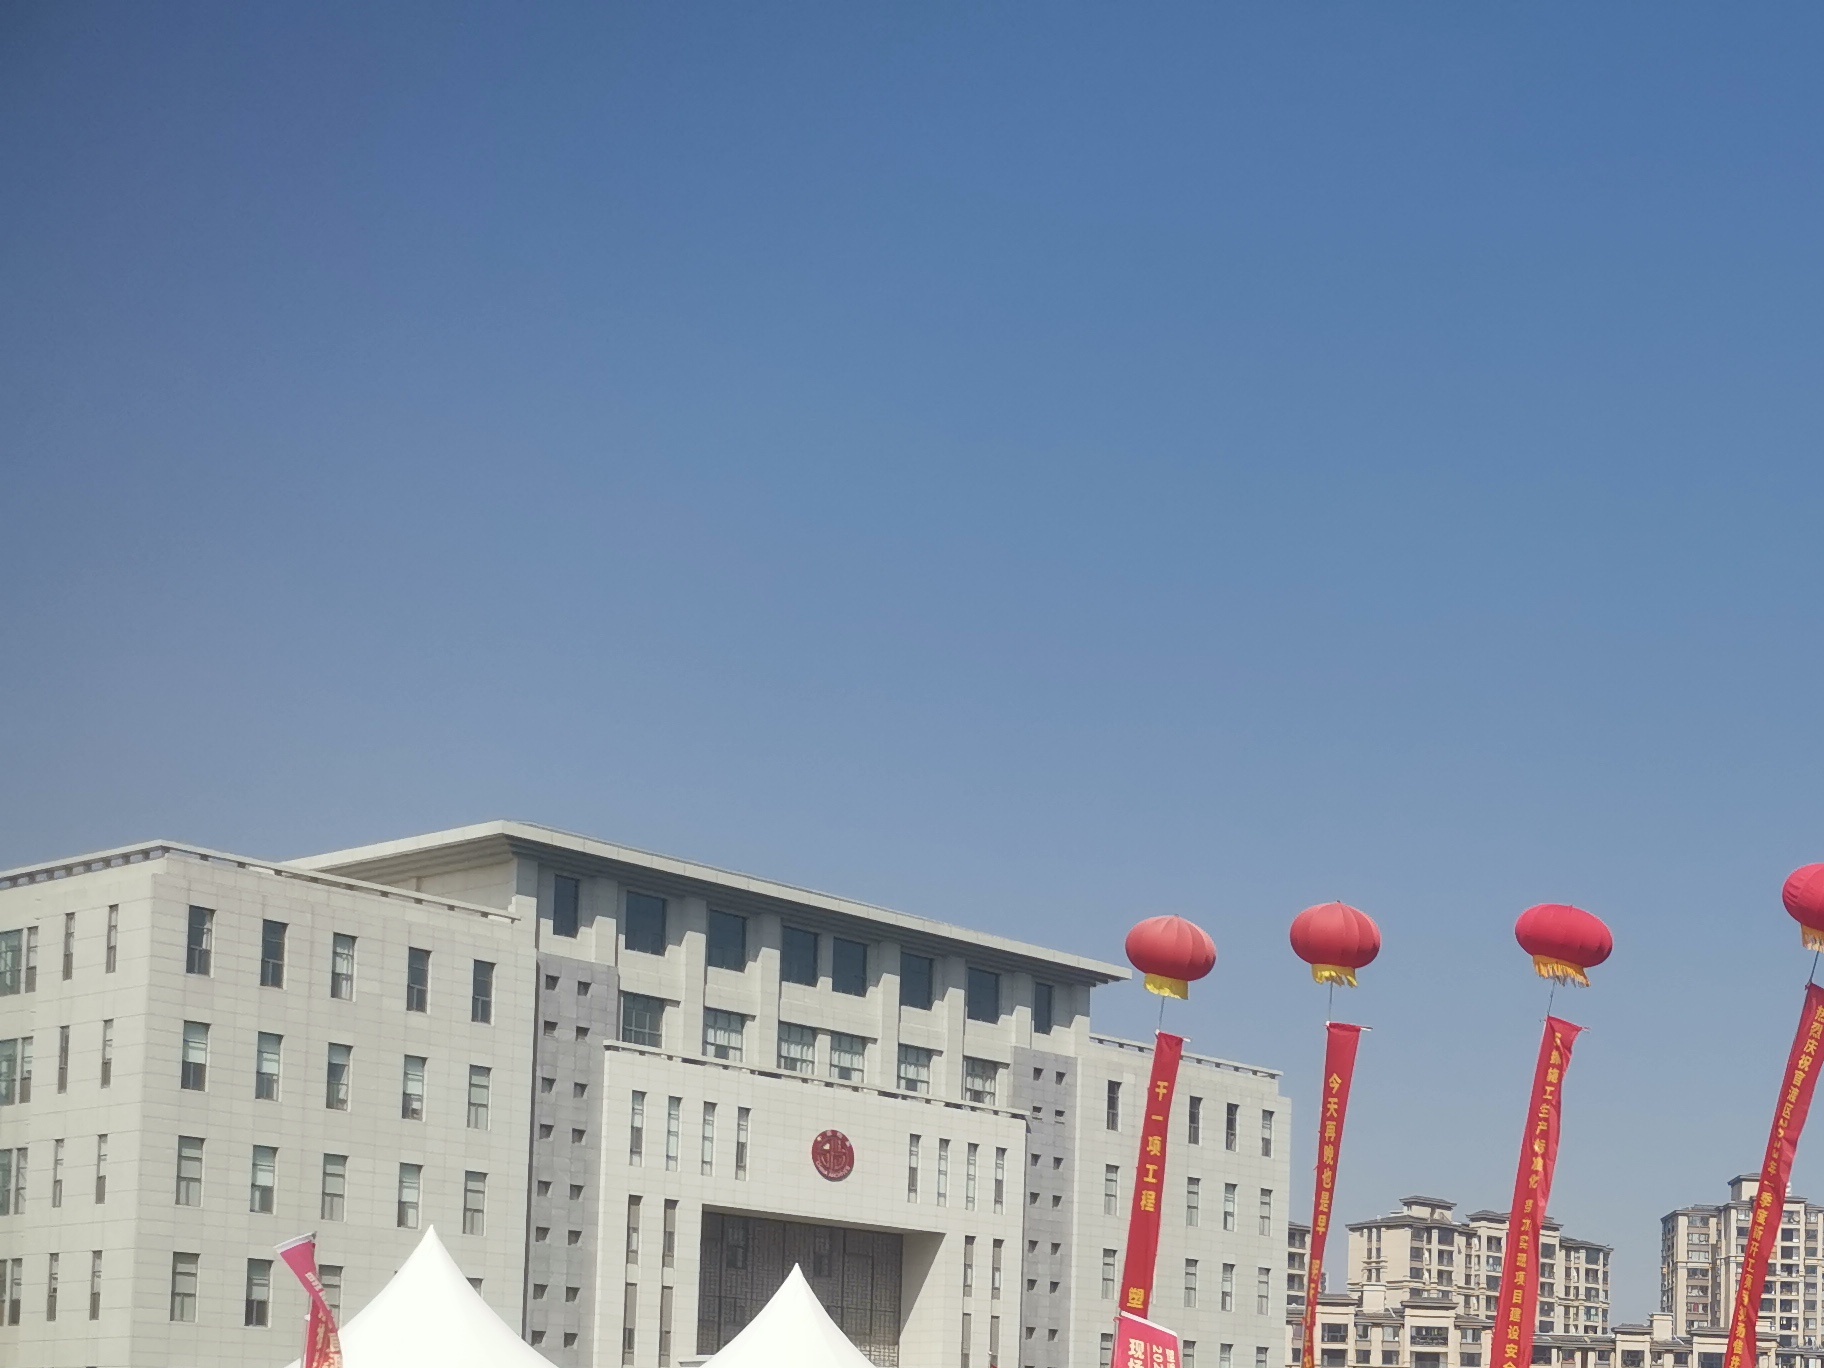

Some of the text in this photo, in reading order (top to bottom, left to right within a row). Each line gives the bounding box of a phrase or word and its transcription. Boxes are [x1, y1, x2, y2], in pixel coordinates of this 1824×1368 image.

[1140, 1081, 1169, 1212] 干一项工程
[1316, 1073, 1342, 1235] 今天再晚也是早
